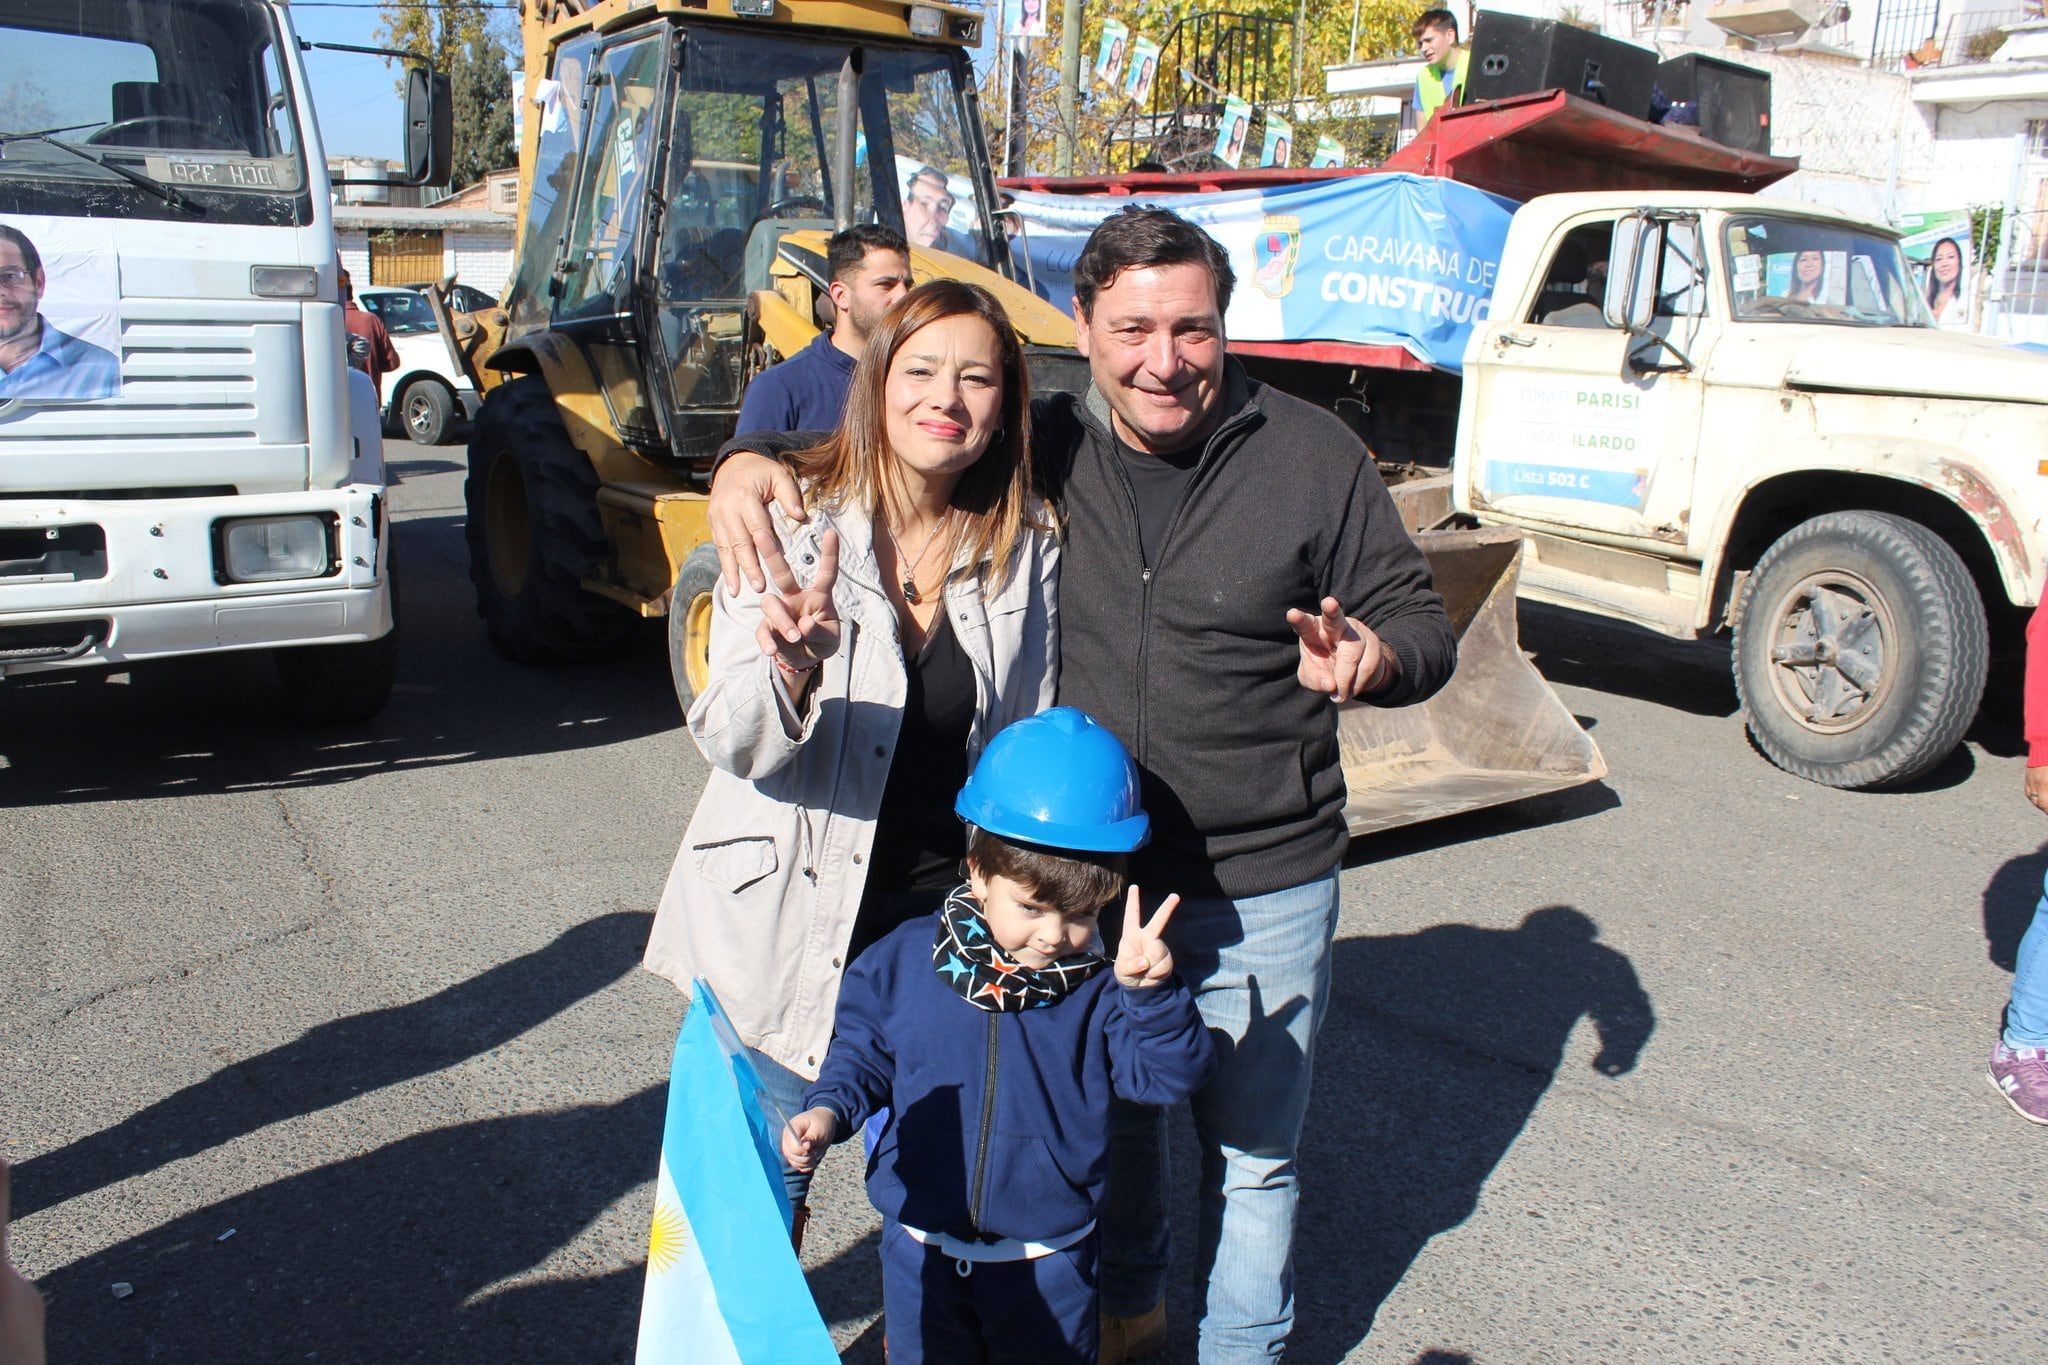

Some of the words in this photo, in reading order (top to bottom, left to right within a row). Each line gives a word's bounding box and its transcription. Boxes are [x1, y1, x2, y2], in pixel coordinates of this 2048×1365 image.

[617, 118, 636, 177] CAT
[1325, 235, 1460, 280] CARAVANA
[1466, 257, 1496, 289] DE
[1321, 271, 1492, 326] CONSTRUC
[1576, 391, 1640, 409] PARISI
[1571, 433, 1636, 451] ILARDO
[1514, 468, 1544, 485] Lista
[1547, 471, 1577, 487] 502
[1579, 474, 1590, 488] C
